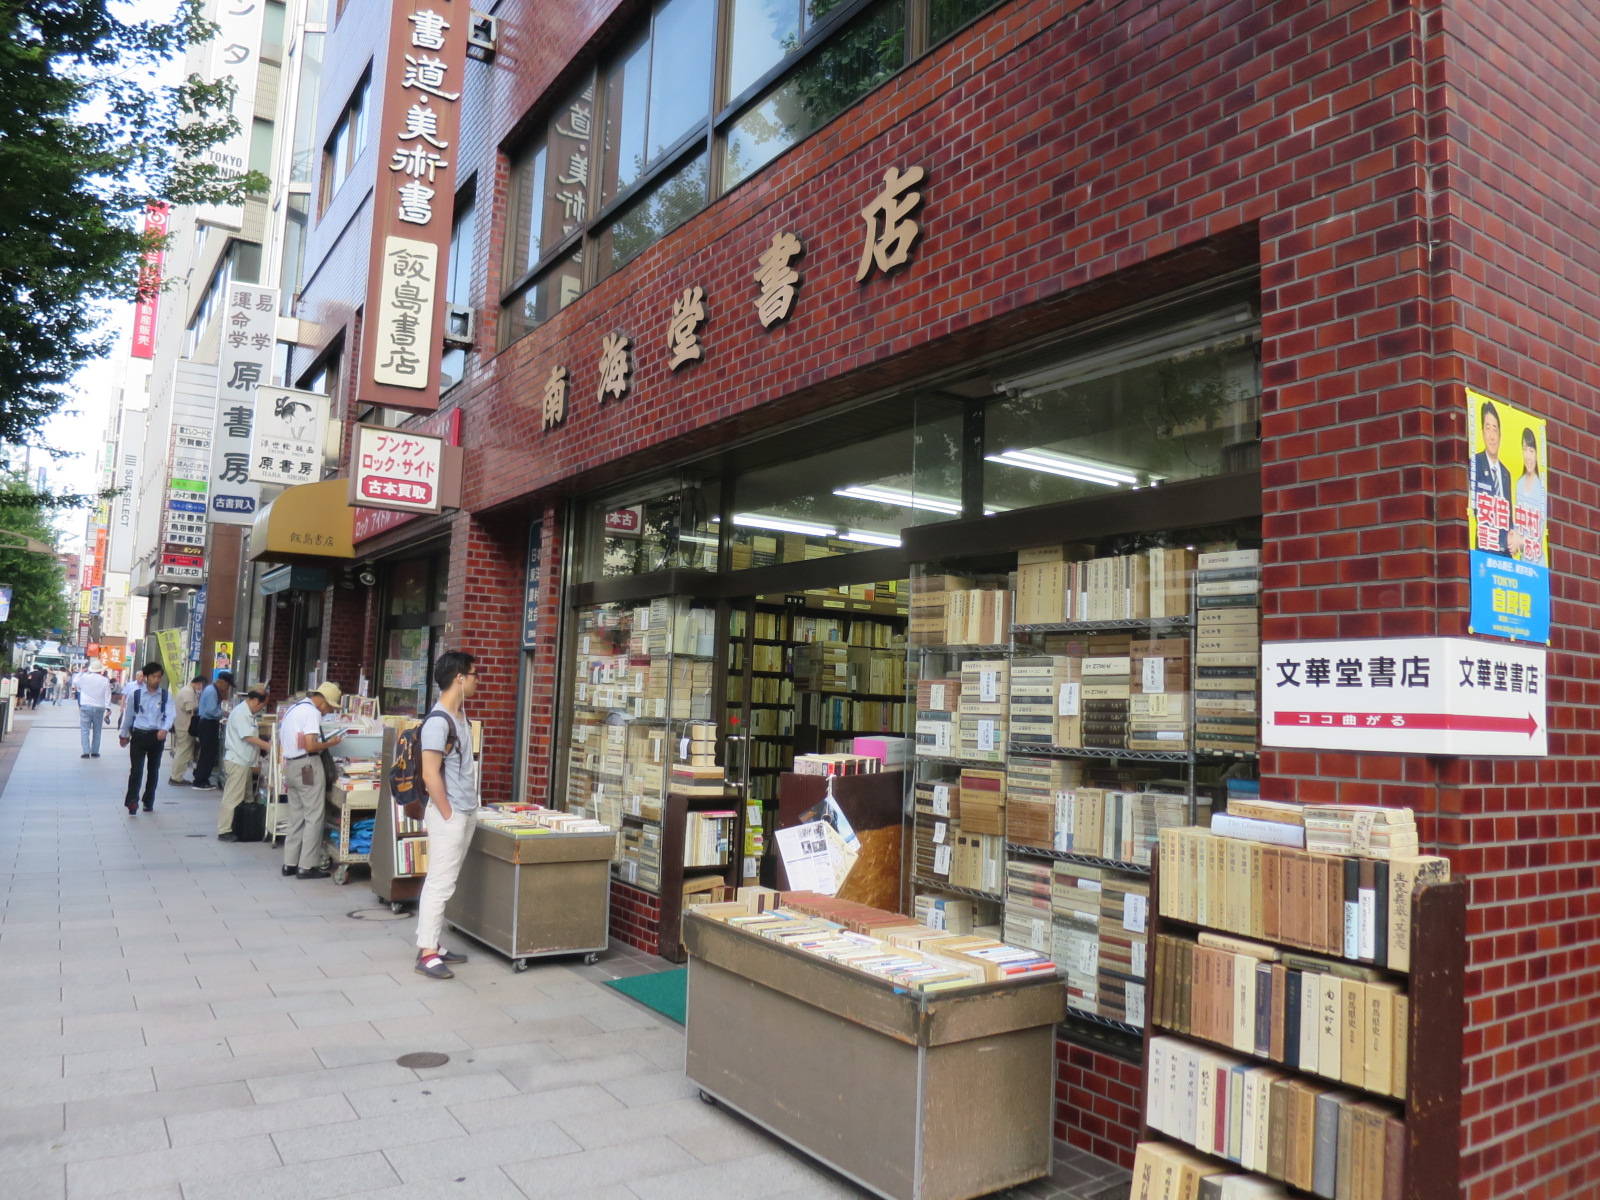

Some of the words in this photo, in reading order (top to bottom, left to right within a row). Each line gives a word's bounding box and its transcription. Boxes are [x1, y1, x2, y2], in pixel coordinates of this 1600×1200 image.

[389, 8, 460, 226] 書道・美術書
[208, 150, 243, 168] TOKYO
[380, 247, 431, 376] 飯島書店
[541, 164, 926, 432] 南海堂書店
[219, 361, 264, 485] 原書房
[376, 435, 426, 457] ブンケン
[258, 455, 314, 477] 原書房
[362, 453, 436, 479] ロック・サイド
[367, 479, 428, 501] 古本買取
[120, 491, 132, 528] SELECT
[1476, 492, 1510, 532] 安倍
[1513, 503, 1541, 540] 中村
[1478, 525, 1500, 552] 晋三
[1523, 538, 1542, 562] あや
[1492, 574, 1518, 589] TOKYO
[1492, 588, 1532, 618] 自民党
[1275, 655, 1432, 689] 文華堂書店
[1458, 655, 1540, 696] 文華堂書店
[1297, 711, 1407, 728] ココ曲がる
